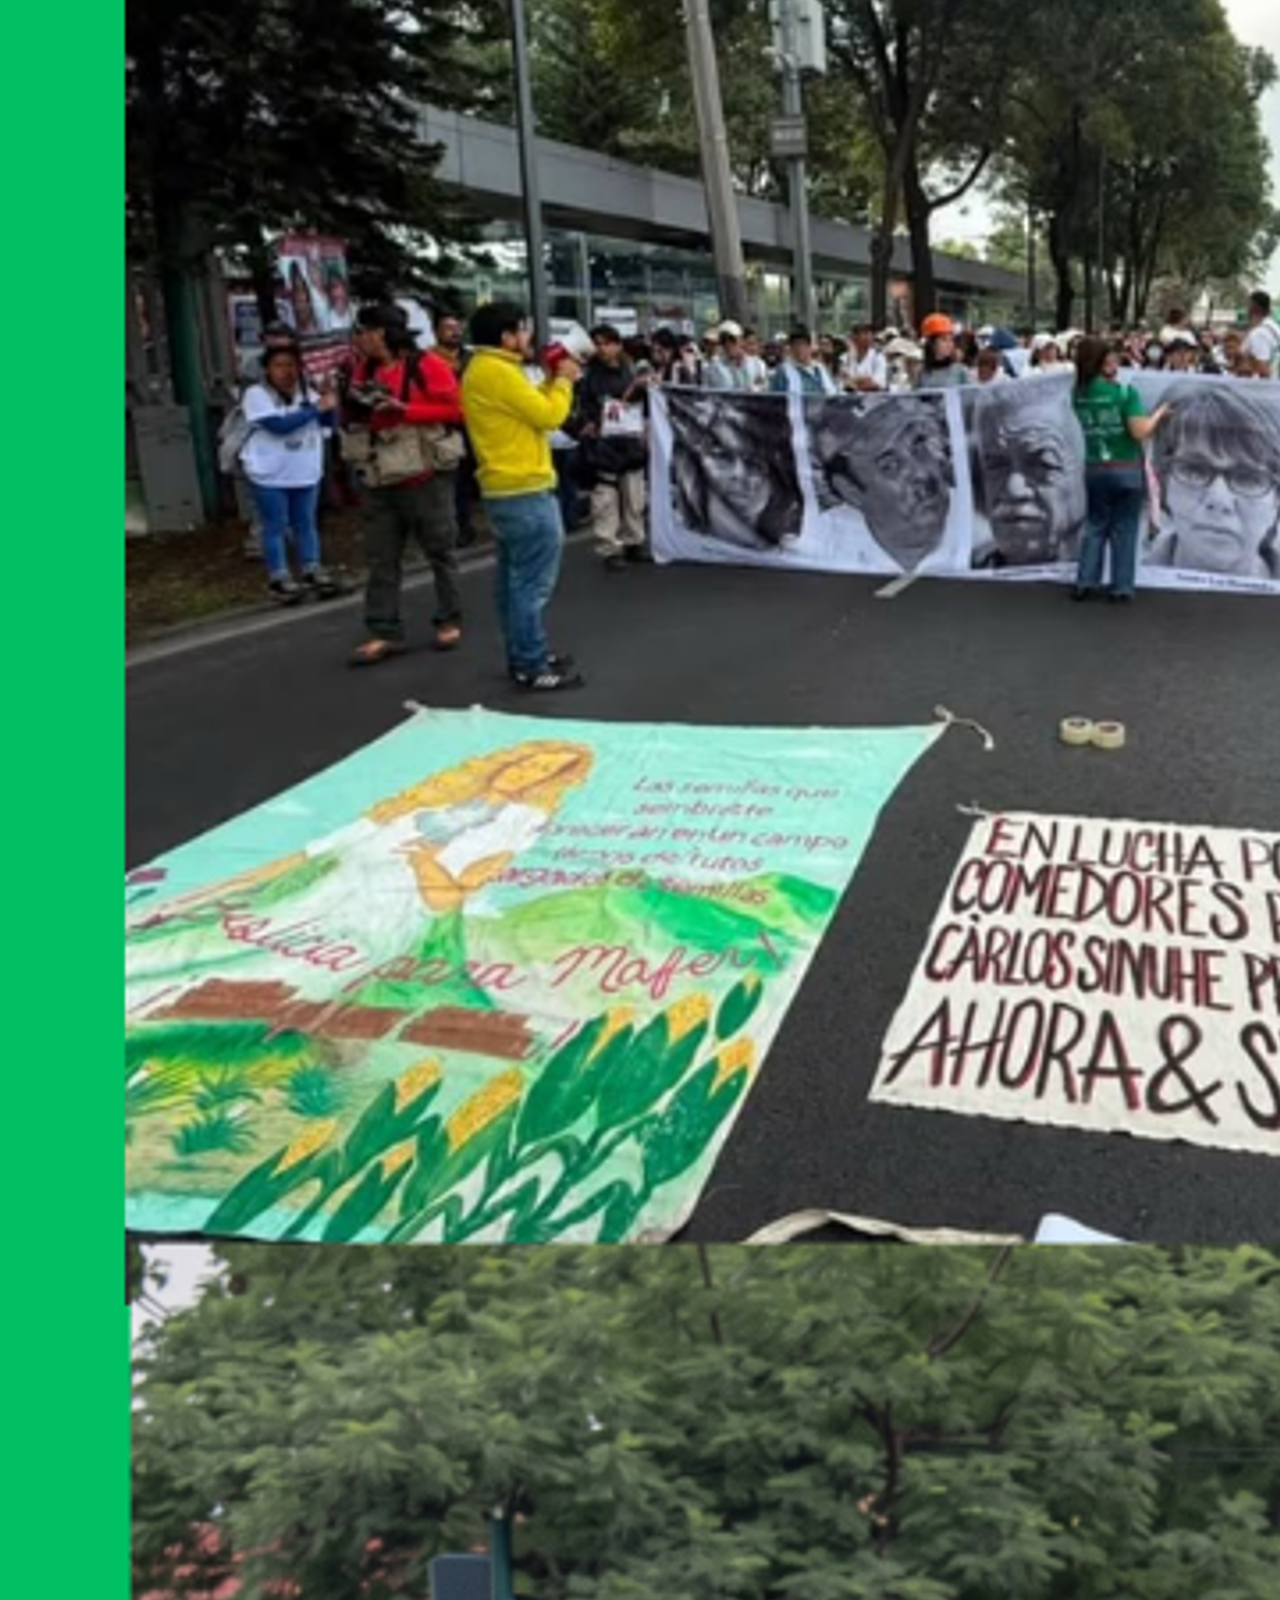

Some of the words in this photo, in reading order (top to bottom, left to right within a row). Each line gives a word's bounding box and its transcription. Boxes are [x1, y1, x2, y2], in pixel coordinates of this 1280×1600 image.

[750, 831, 849, 852] campo
[985, 818, 1058, 860] EN
[1068, 824, 1225, 878] LUCHA
[952, 857, 1250, 942] COMEDORES
[1077, 934, 1234, 1011] SINUHE
[881, 996, 1144, 1111] AHORA
[1145, 1013, 1224, 1126] &
